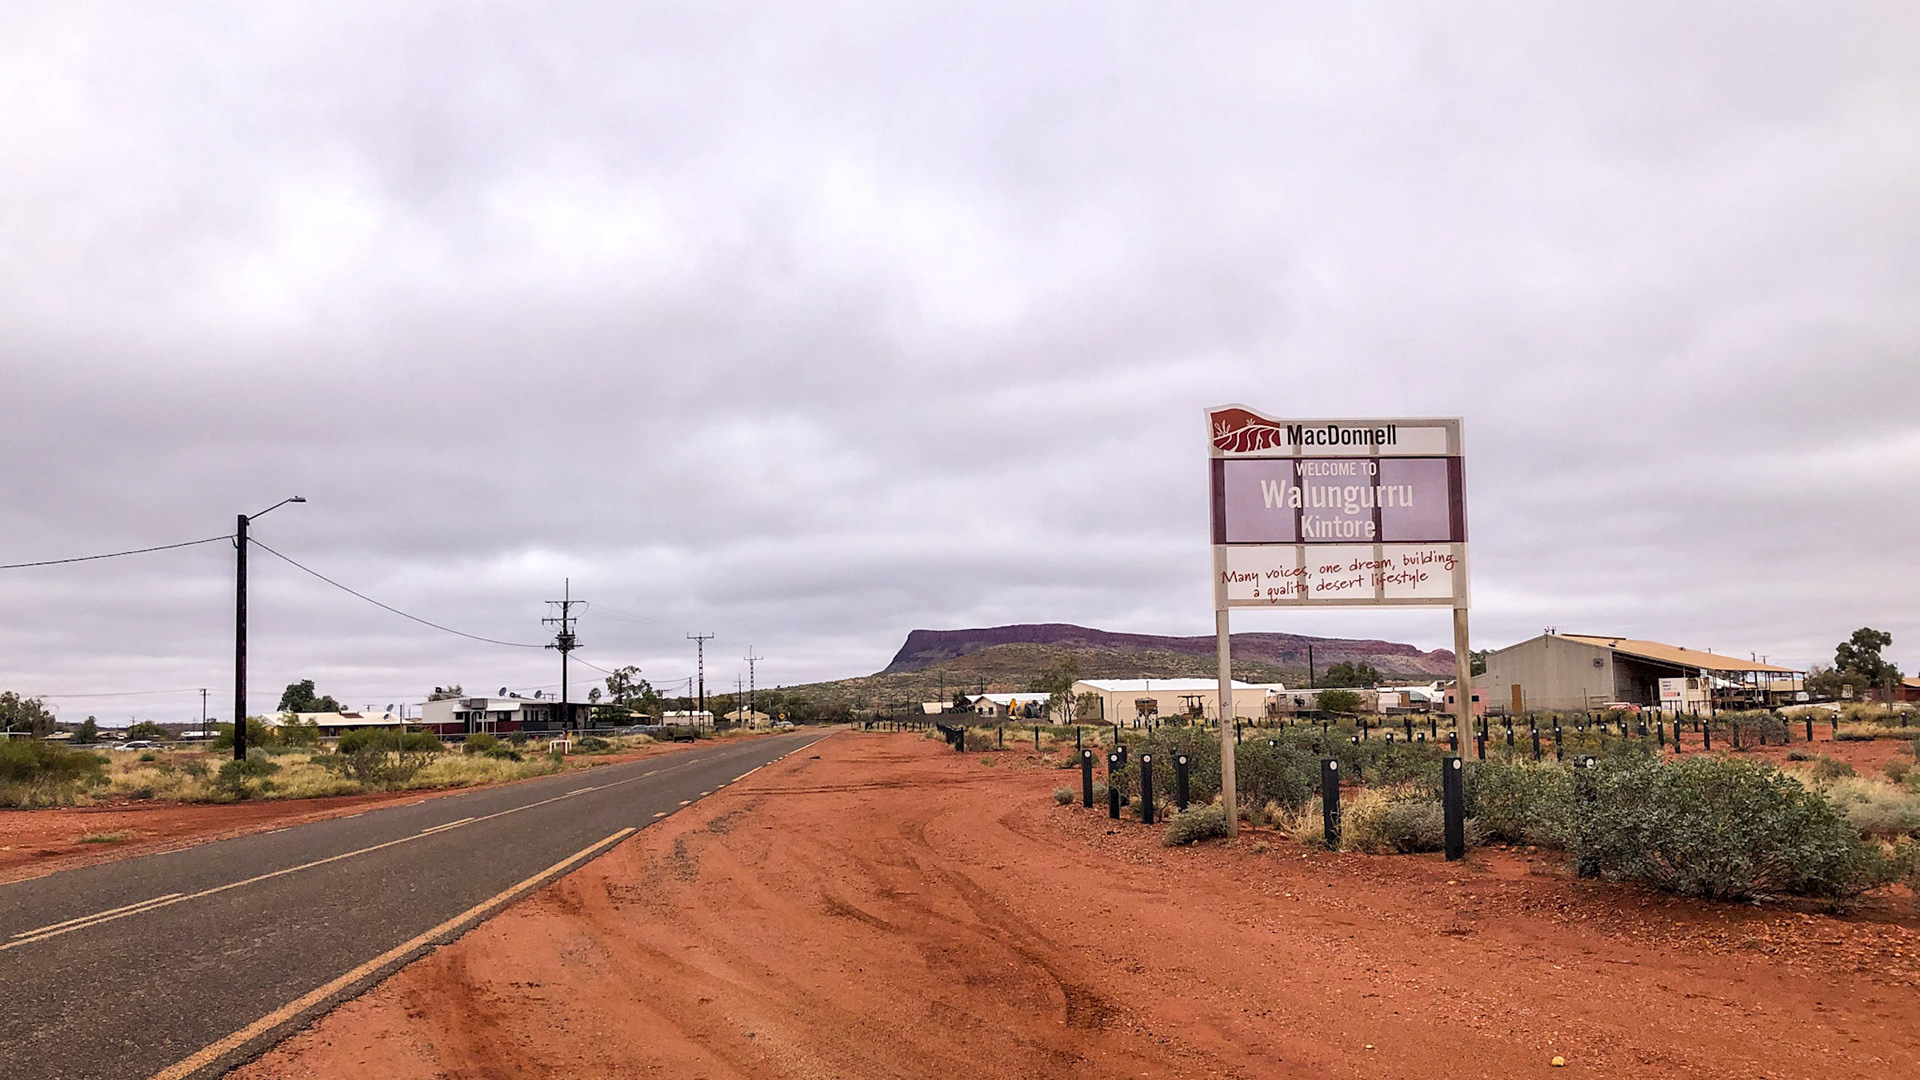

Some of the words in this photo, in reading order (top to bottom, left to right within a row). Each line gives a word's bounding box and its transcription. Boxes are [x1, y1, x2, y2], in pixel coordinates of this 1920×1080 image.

[1287, 424, 1397, 446] MacDonnell
[1296, 462, 1357, 477] WELCOME
[1361, 461, 1377, 476] TO
[1261, 479, 1414, 515] Walungurru
[1301, 515, 1376, 538] Kintore
[1221, 570, 1260, 588] Many
[1266, 565, 1313, 580] voices,
[1319, 564, 1342, 574] one
[1349, 557, 1396, 572] dream,
[1402, 550, 1459, 571] building
[1253, 588, 1260, 598] a
[1267, 579, 1309, 604] quality
[1316, 574, 1365, 592] desert
[1370, 569, 1429, 591] lifestyle
